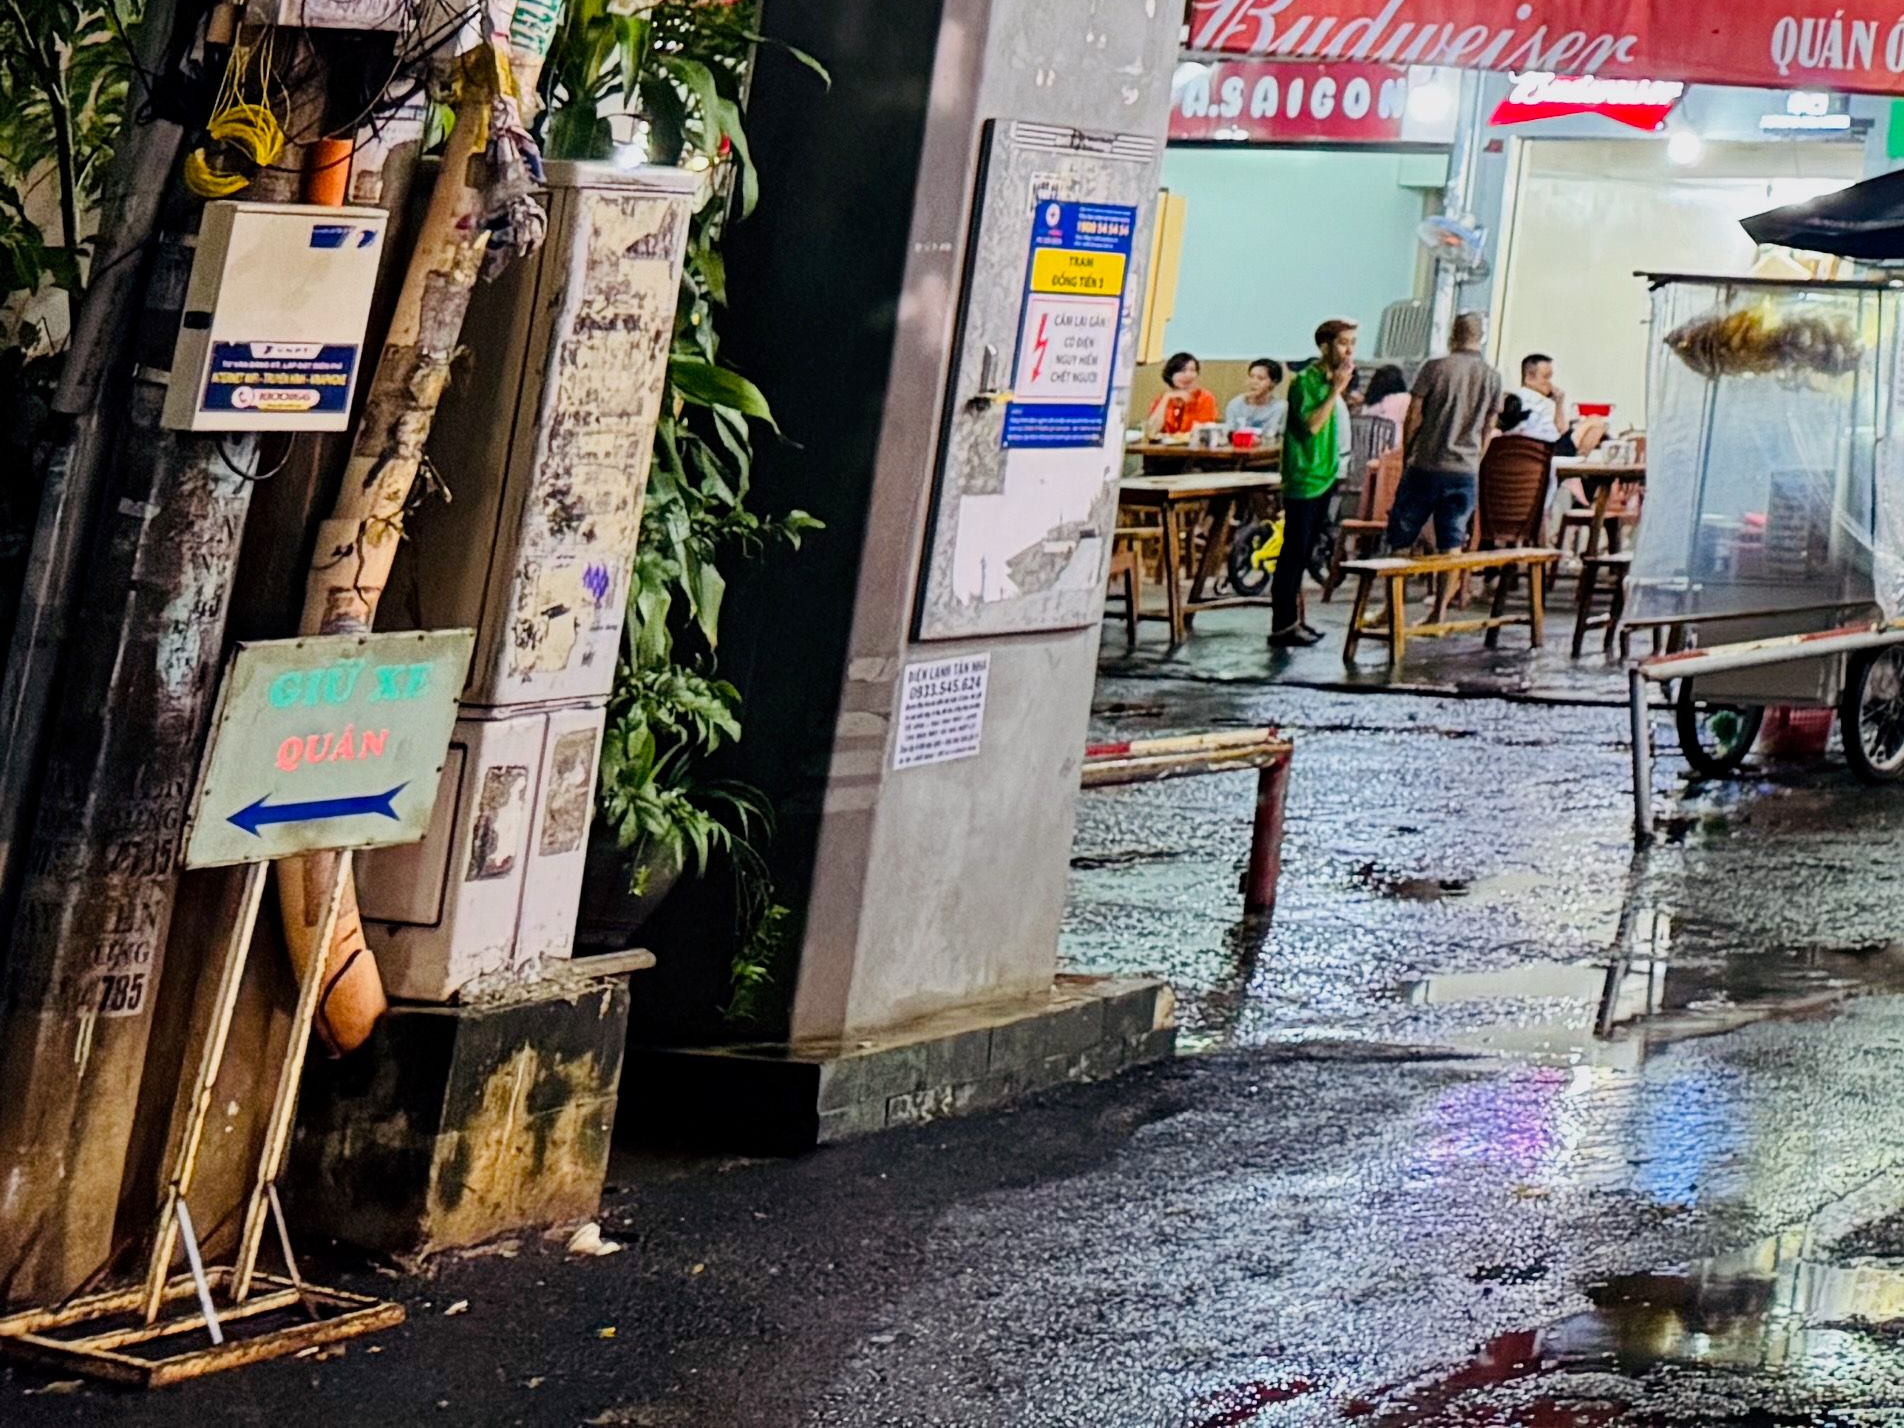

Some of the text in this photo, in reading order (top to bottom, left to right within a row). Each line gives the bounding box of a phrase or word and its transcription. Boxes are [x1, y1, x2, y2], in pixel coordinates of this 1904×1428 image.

[1770, 9, 1880, 77] QUÁN
[268, 657, 367, 709] GIỮ
[274, 723, 391, 773] QUÁN
